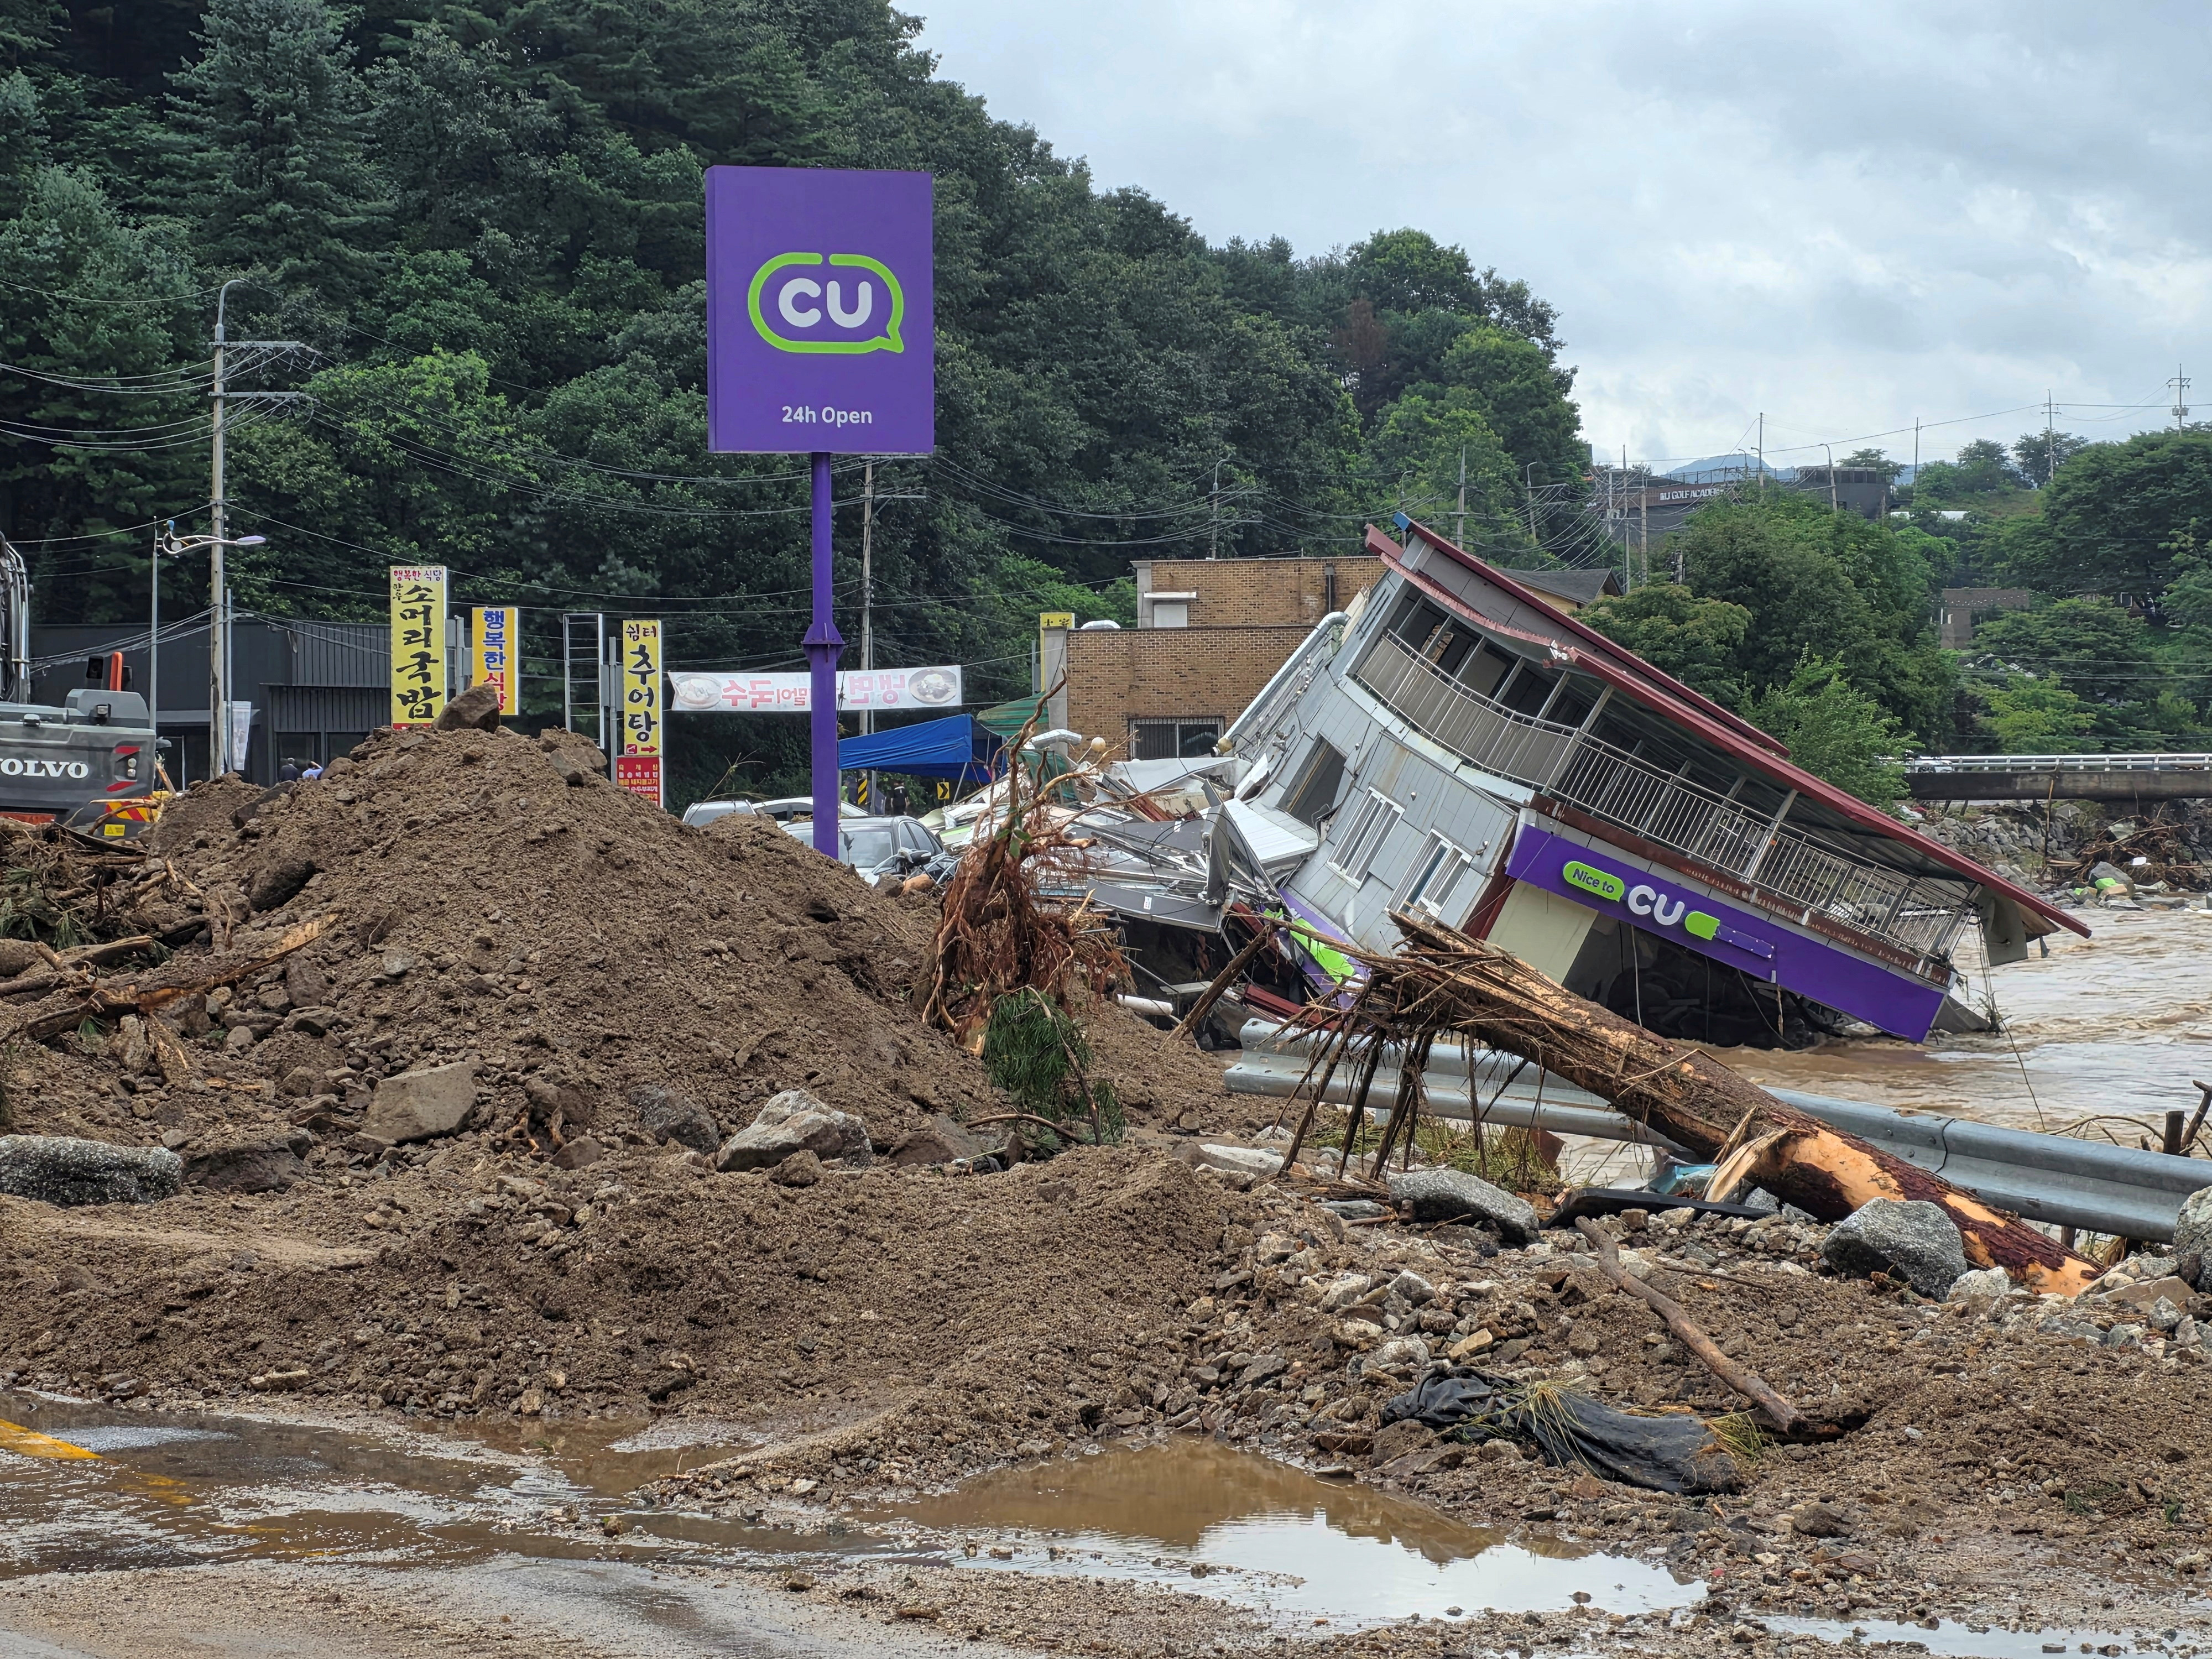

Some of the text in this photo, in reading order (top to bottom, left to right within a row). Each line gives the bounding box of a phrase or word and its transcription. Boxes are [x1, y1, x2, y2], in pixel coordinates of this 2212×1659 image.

[778, 278, 872, 328] CU
[781, 405, 873, 429] 24h Open
[1671, 491, 1690, 499] GOLF
[393, 570, 442, 581] 행복한 식당
[483, 610, 507, 671] 행복한
[625, 624, 656, 641] 쉼터
[396, 585, 442, 719] 소머리국밥
[628, 644, 658, 742] 추어탕
[0, 758, 89, 779] OLVO
[1572, 868, 1686, 926] Nice to CU
